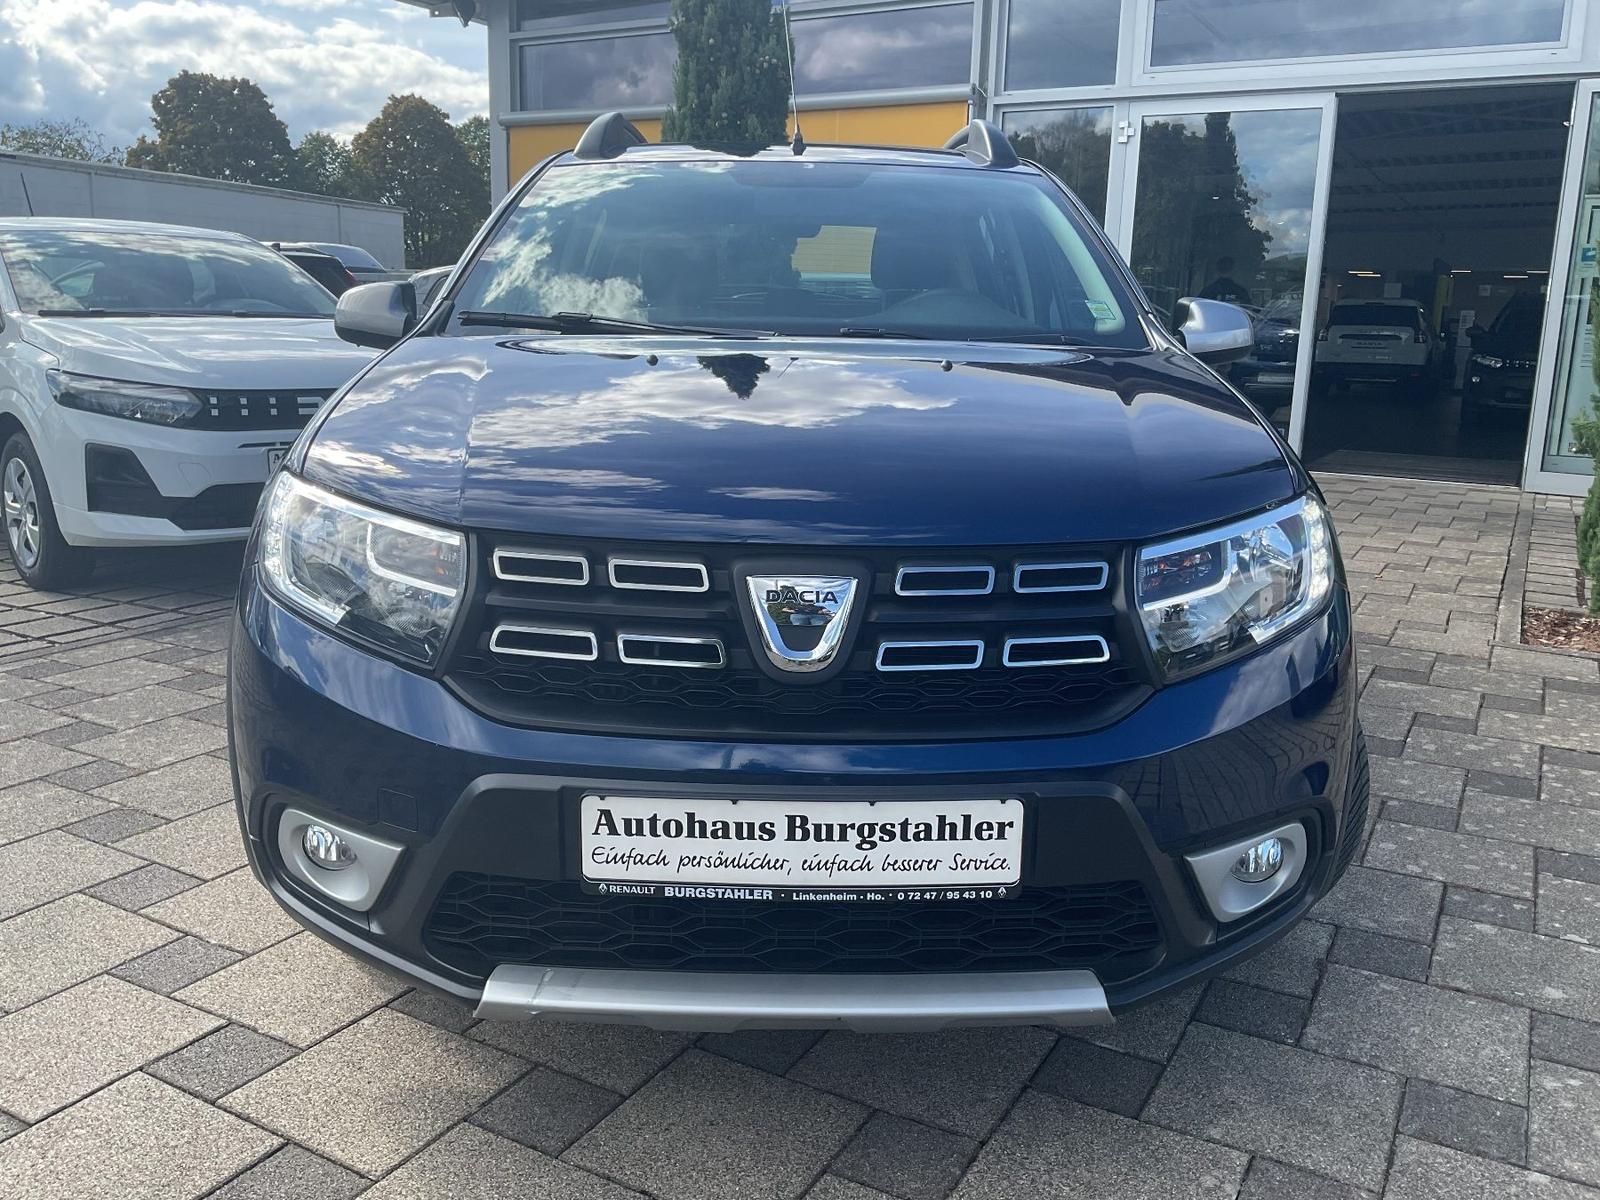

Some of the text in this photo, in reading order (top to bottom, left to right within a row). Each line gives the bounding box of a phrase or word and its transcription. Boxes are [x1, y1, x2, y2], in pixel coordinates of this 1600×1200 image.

[765, 589, 839, 604] DACIA
[592, 808, 1014, 851] Autohaus Burgstahler
[591, 846, 1011, 878] Einfach persönlicher, einfach besserer Service.
[609, 885, 656, 895] RENAULT
[664, 886, 773, 900] BURGSTAHLER
[792, 892, 857, 901] Linkenheim
[866, 892, 885, 901] Ho.
[897, 891, 905, 900] 0
[907, 891, 921, 900] 72
[923, 891, 937, 900] 47
[946, 891, 960, 900] 95
[962, 890, 976, 899] 43
[979, 890, 993, 899] 10
